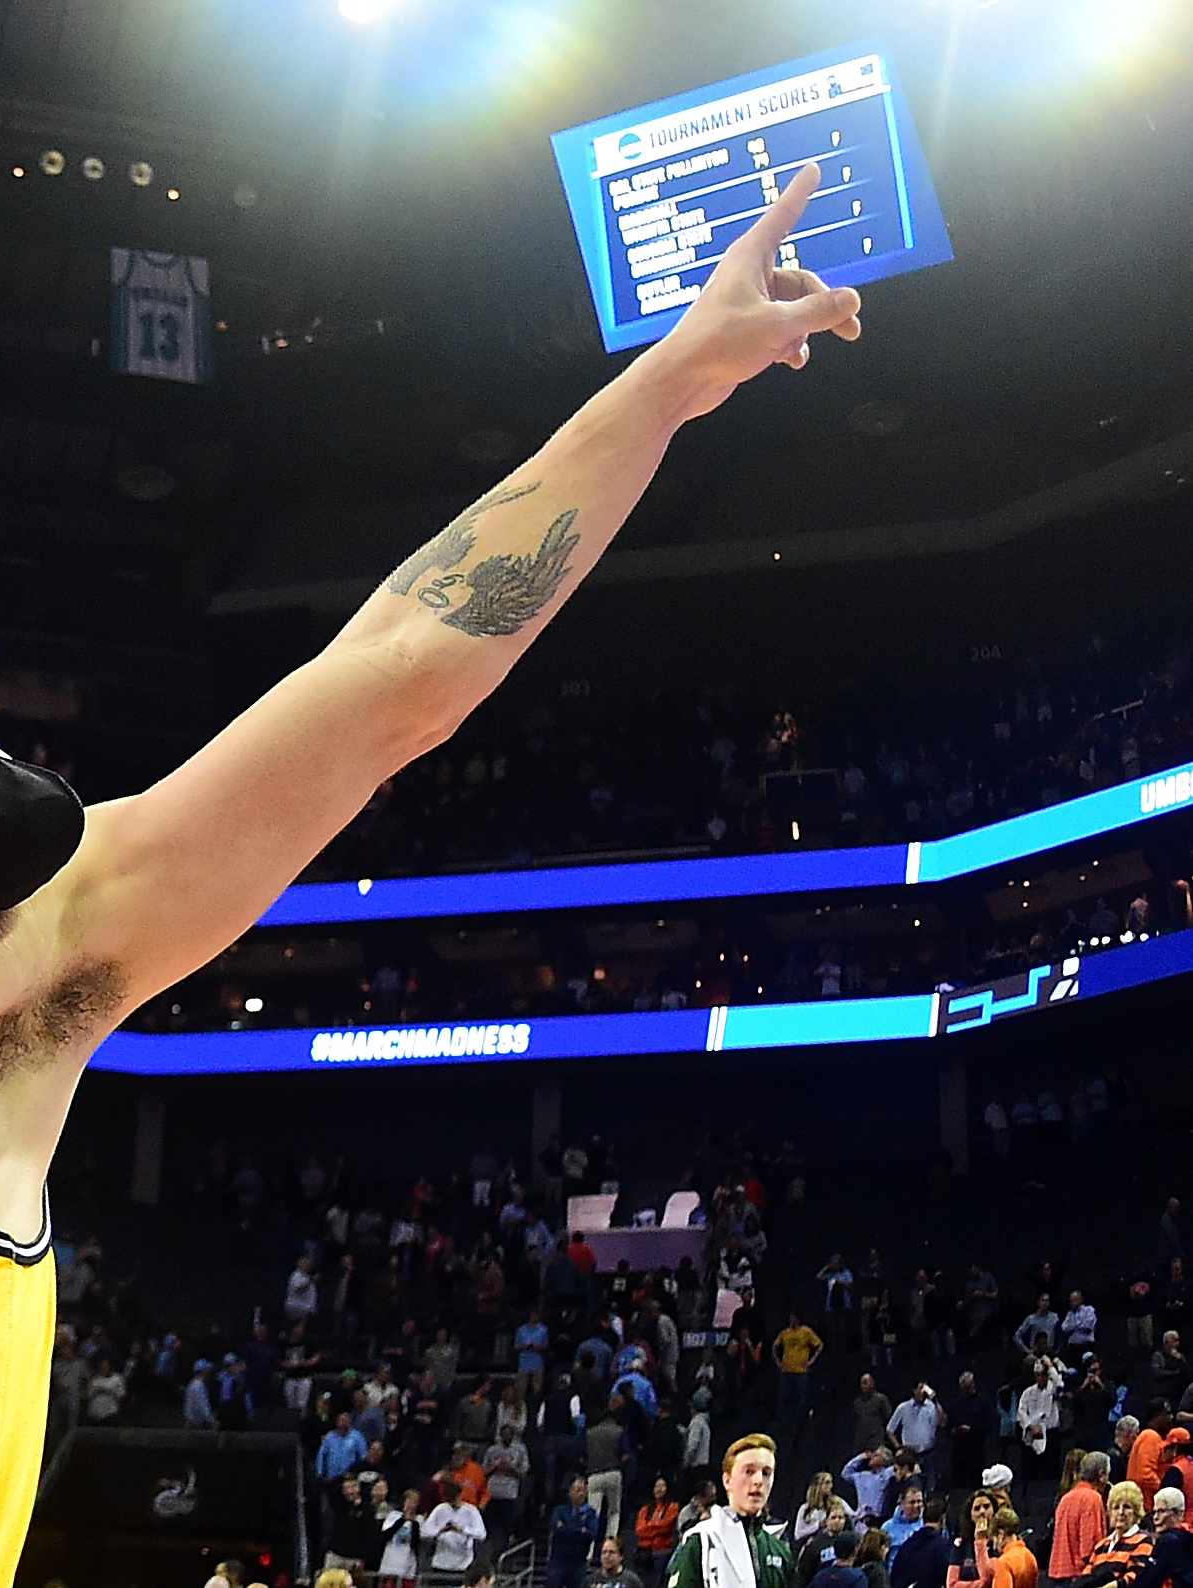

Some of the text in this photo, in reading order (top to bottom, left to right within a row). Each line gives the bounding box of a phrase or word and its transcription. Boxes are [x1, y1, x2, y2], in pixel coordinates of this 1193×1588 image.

[649, 83, 820, 148] TOURNAMENT SCORES
[140, 312, 181, 363] 13
[1140, 769, 1193, 814] UMB
[311, 1023, 531, 1063] #MARCHMADNESS
